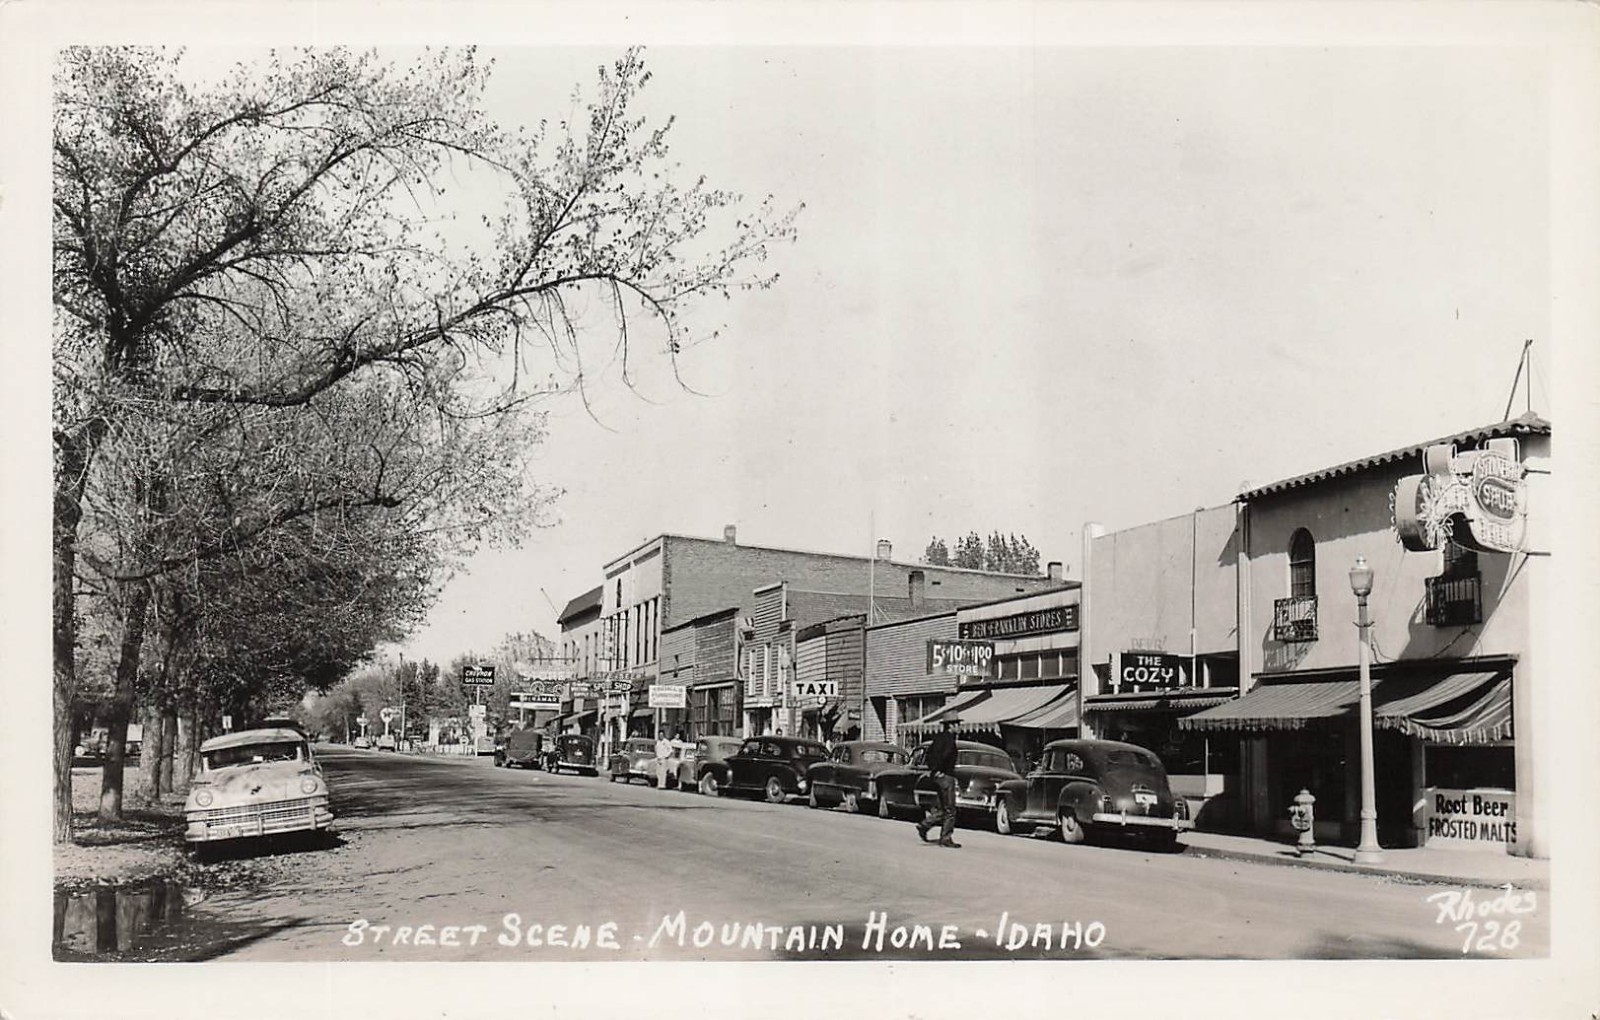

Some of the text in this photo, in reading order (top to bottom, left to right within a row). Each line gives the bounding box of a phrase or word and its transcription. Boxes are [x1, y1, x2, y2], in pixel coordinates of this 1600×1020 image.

[972, 611, 1062, 637] BEN FRANKLIN STORES
[1137, 655, 1162, 666] THE
[946, 664, 979, 674] STORE
[1123, 666, 1174, 683] COZY
[614, 681, 631, 691] SHOP
[796, 683, 835, 695] TAXI
[1435, 793, 1508, 816] Root Beer
[1429, 817, 1517, 843] FROSTED MALTS
